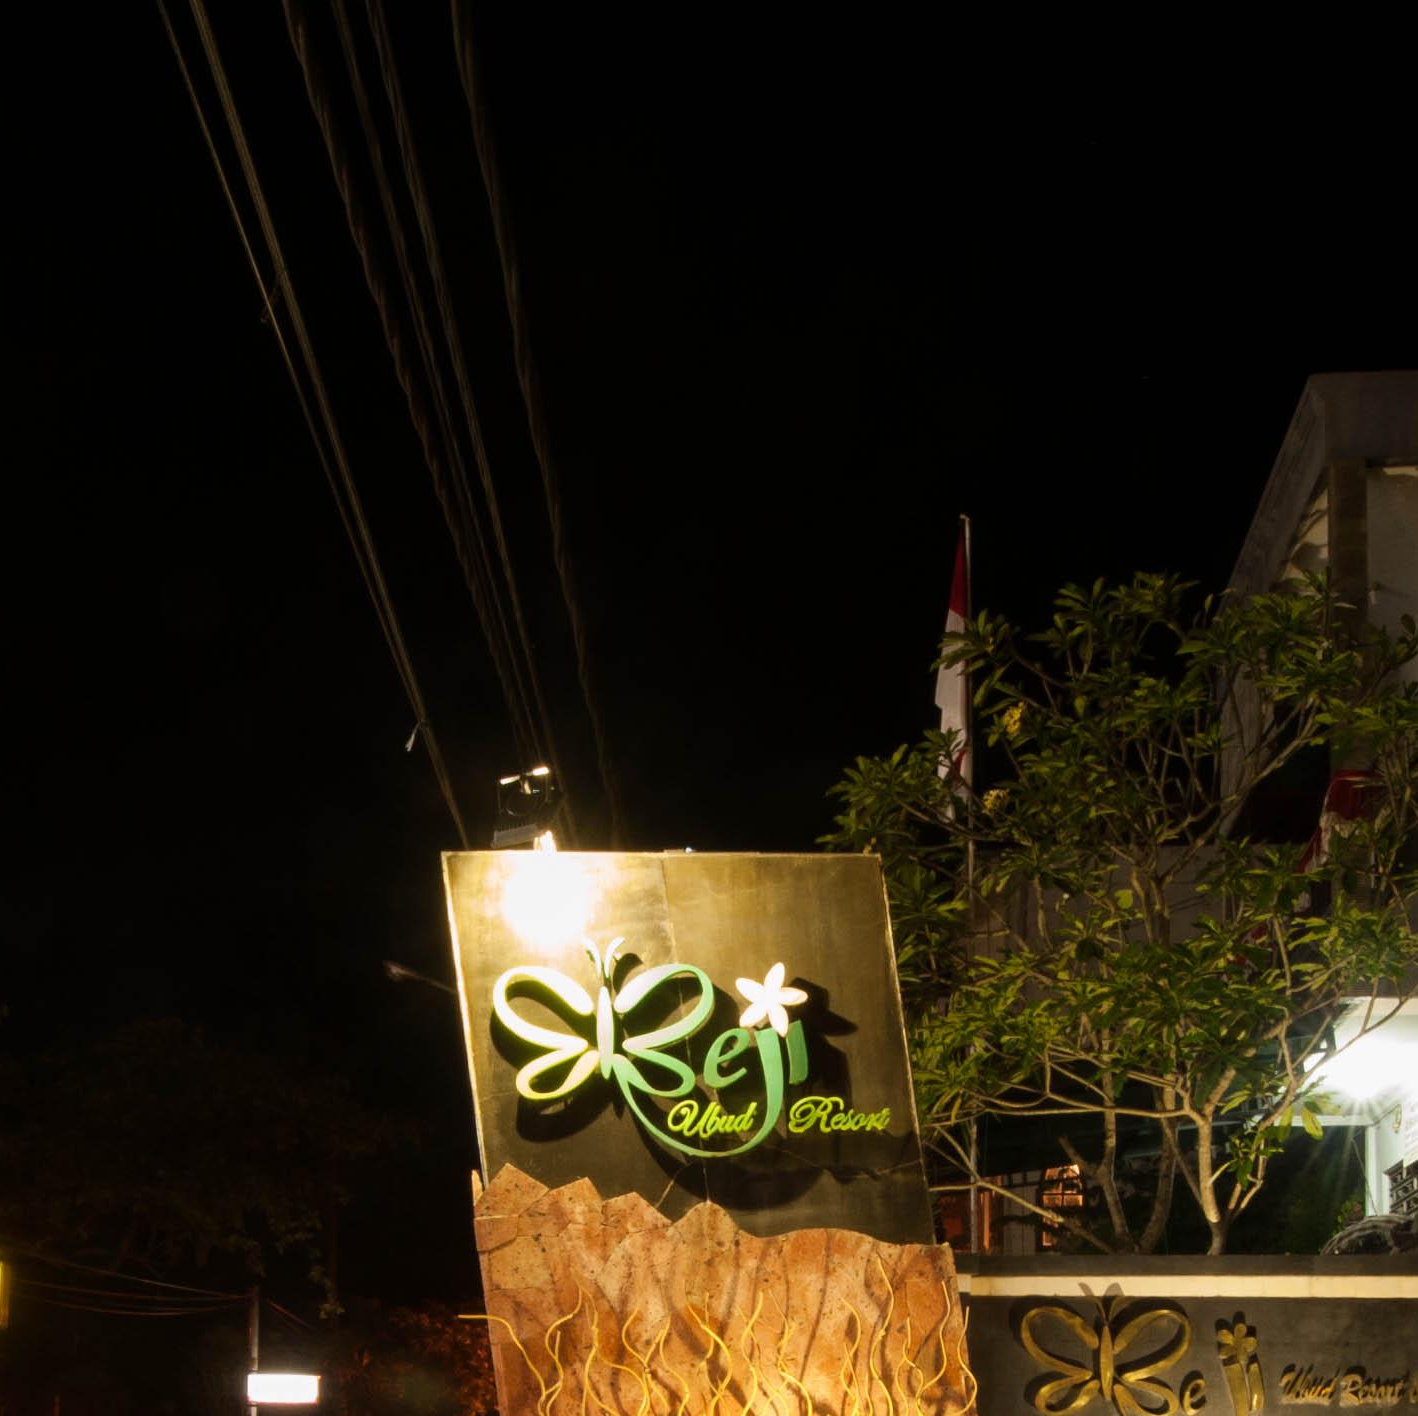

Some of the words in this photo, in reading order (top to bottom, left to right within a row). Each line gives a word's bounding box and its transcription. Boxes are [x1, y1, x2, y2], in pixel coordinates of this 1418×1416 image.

[667, 1099, 758, 1139] Ubud
[788, 1096, 890, 1133] Resort
[1339, 1369, 1408, 1406] Resort
